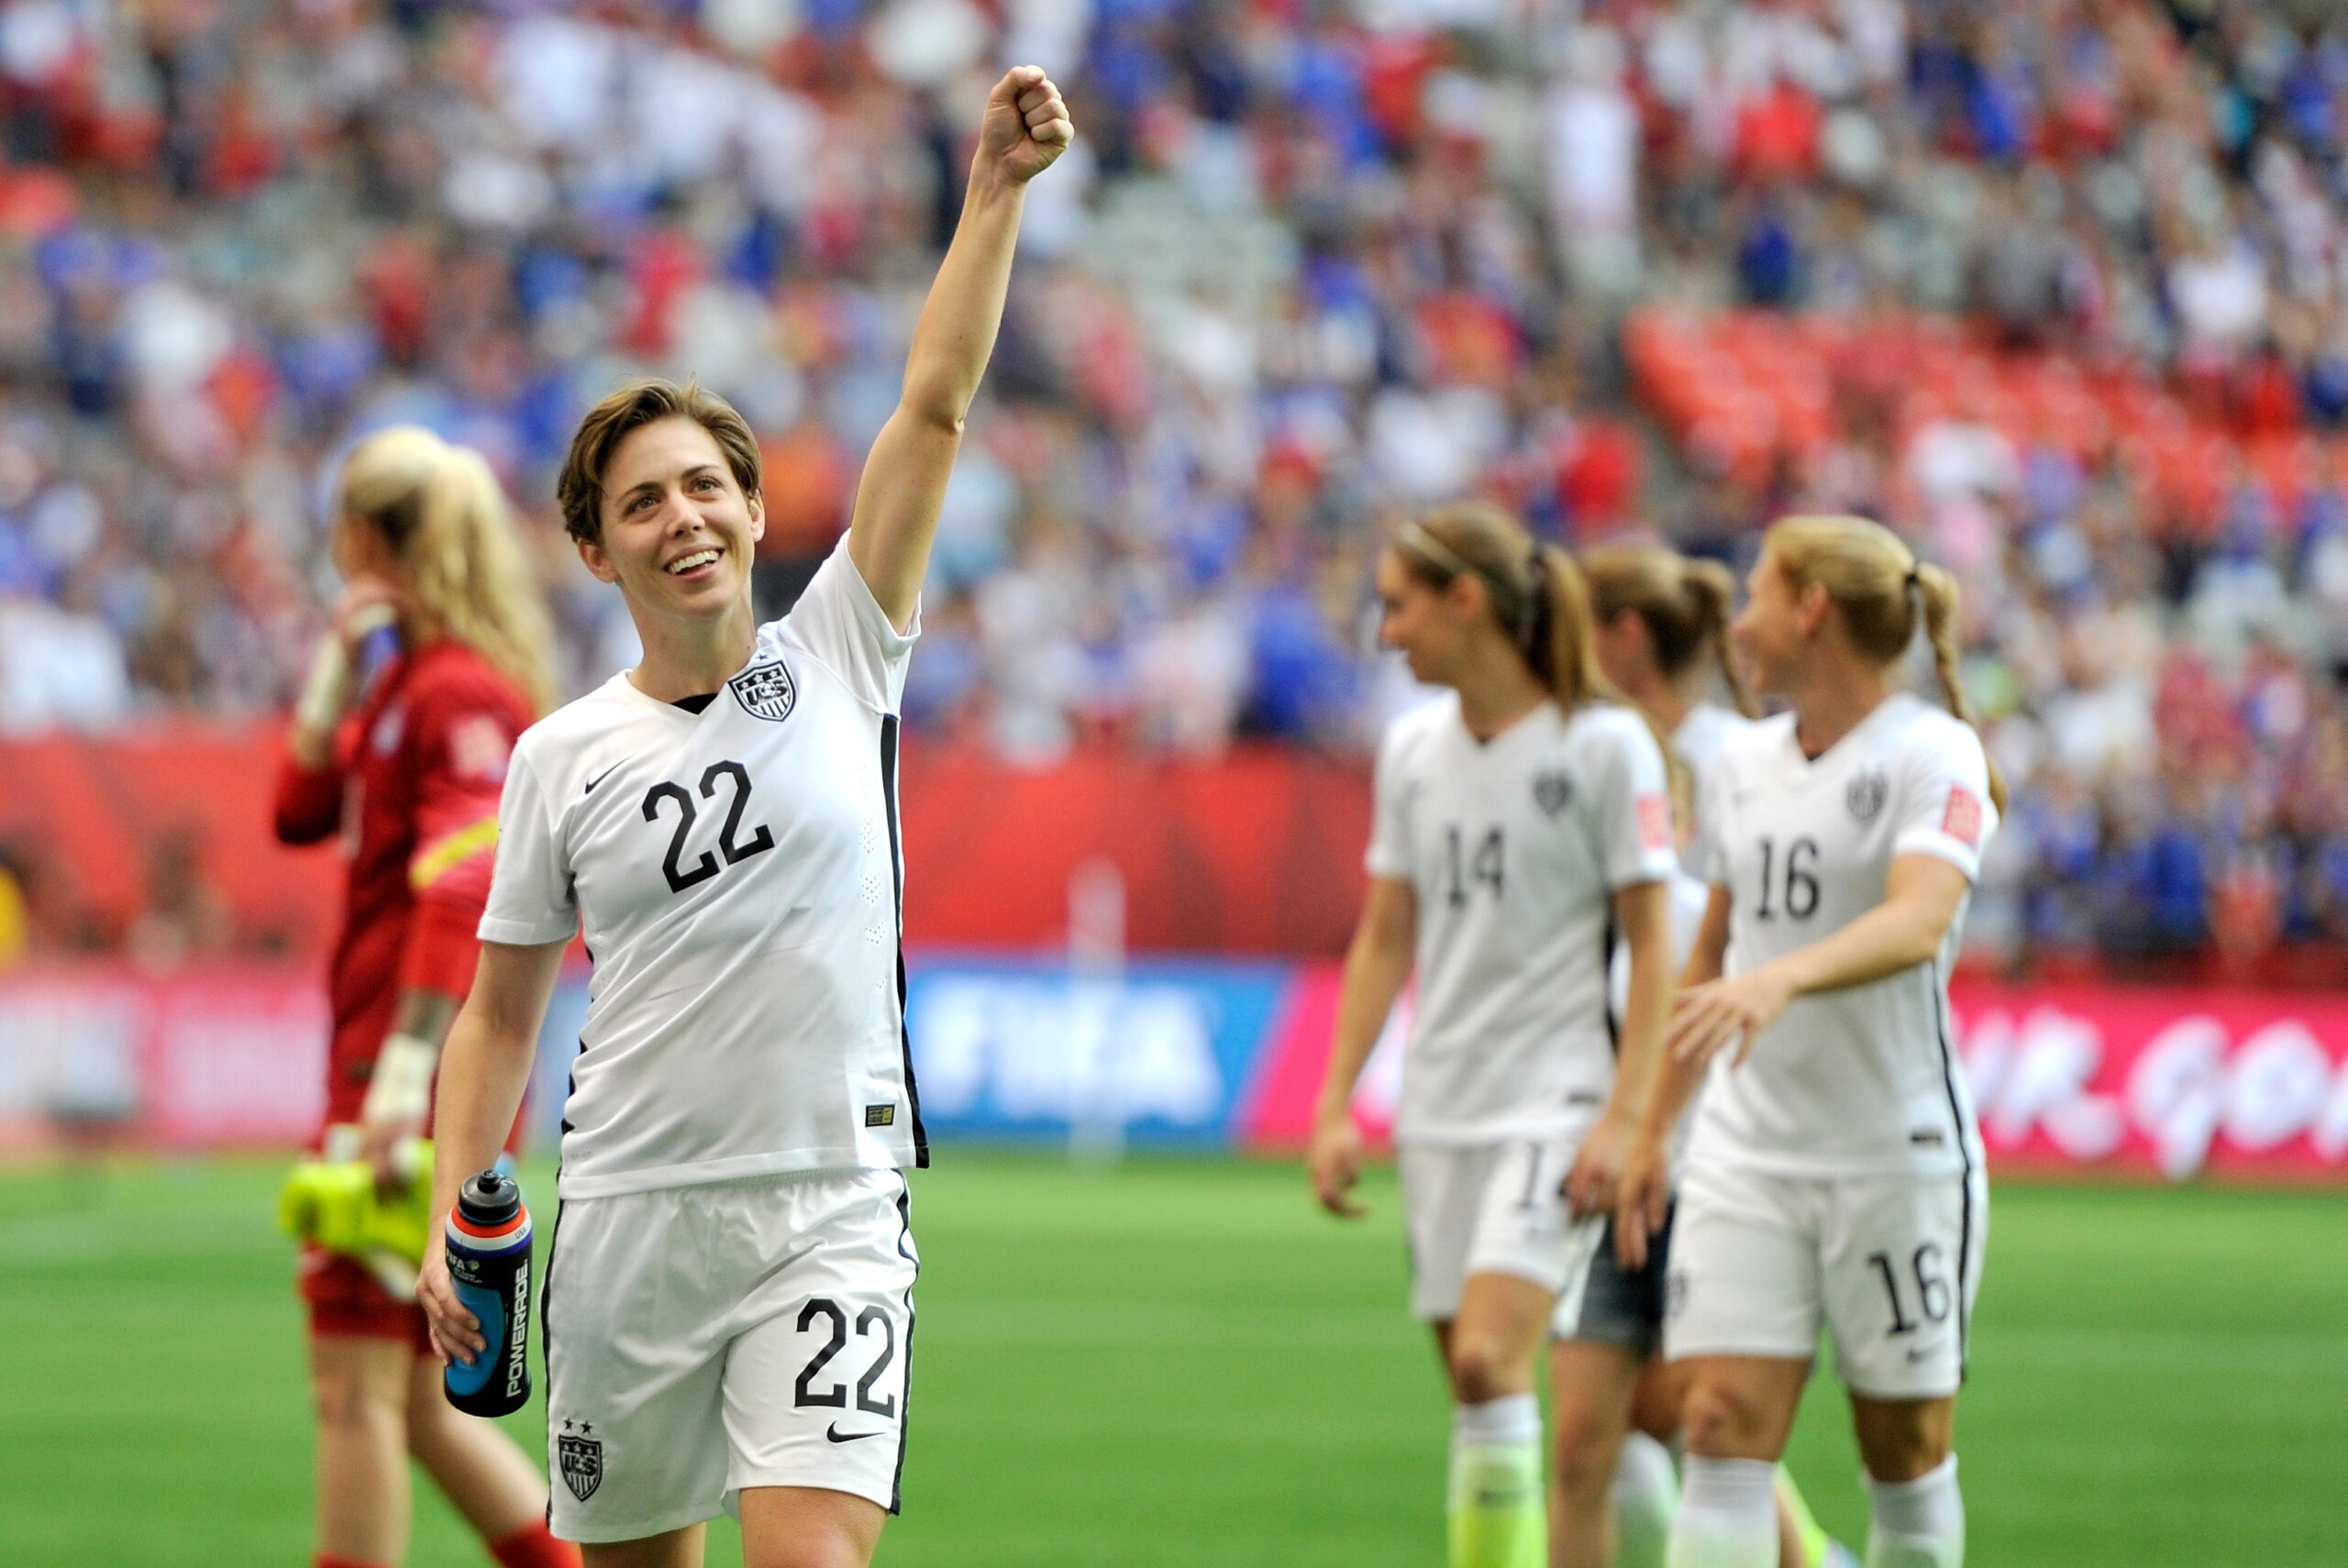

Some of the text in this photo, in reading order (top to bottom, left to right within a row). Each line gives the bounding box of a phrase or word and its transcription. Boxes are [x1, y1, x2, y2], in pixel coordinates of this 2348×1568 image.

[642, 759, 775, 893] 22
[1445, 823, 1505, 908] 14
[1755, 833, 1821, 922] 16
[506, 1264, 528, 1398] POWERADE
[1868, 1242, 1950, 1339] 16
[794, 1298, 895, 1419] 22
